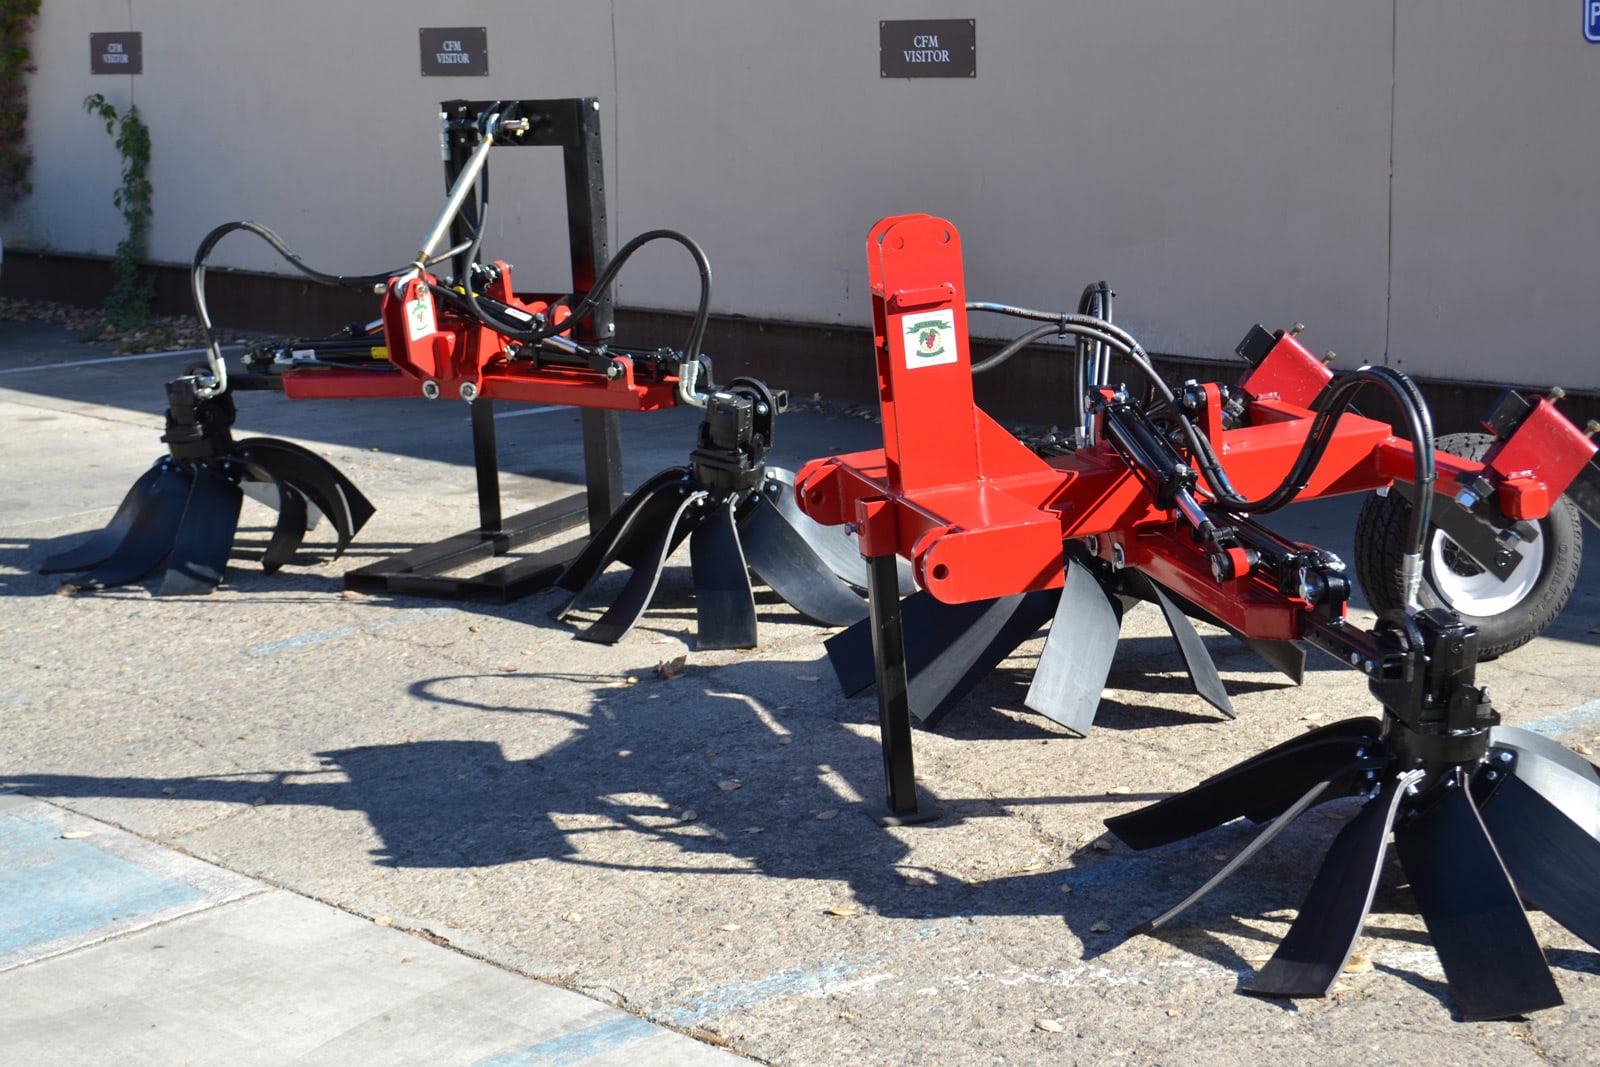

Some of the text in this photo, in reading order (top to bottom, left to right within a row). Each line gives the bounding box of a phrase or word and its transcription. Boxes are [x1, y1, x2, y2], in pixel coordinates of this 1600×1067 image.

[443, 40, 462, 51] CFM
[913, 35, 939, 48] CFM
[436, 52, 471, 64] VISITOR
[903, 49, 951, 63] VISITOR
